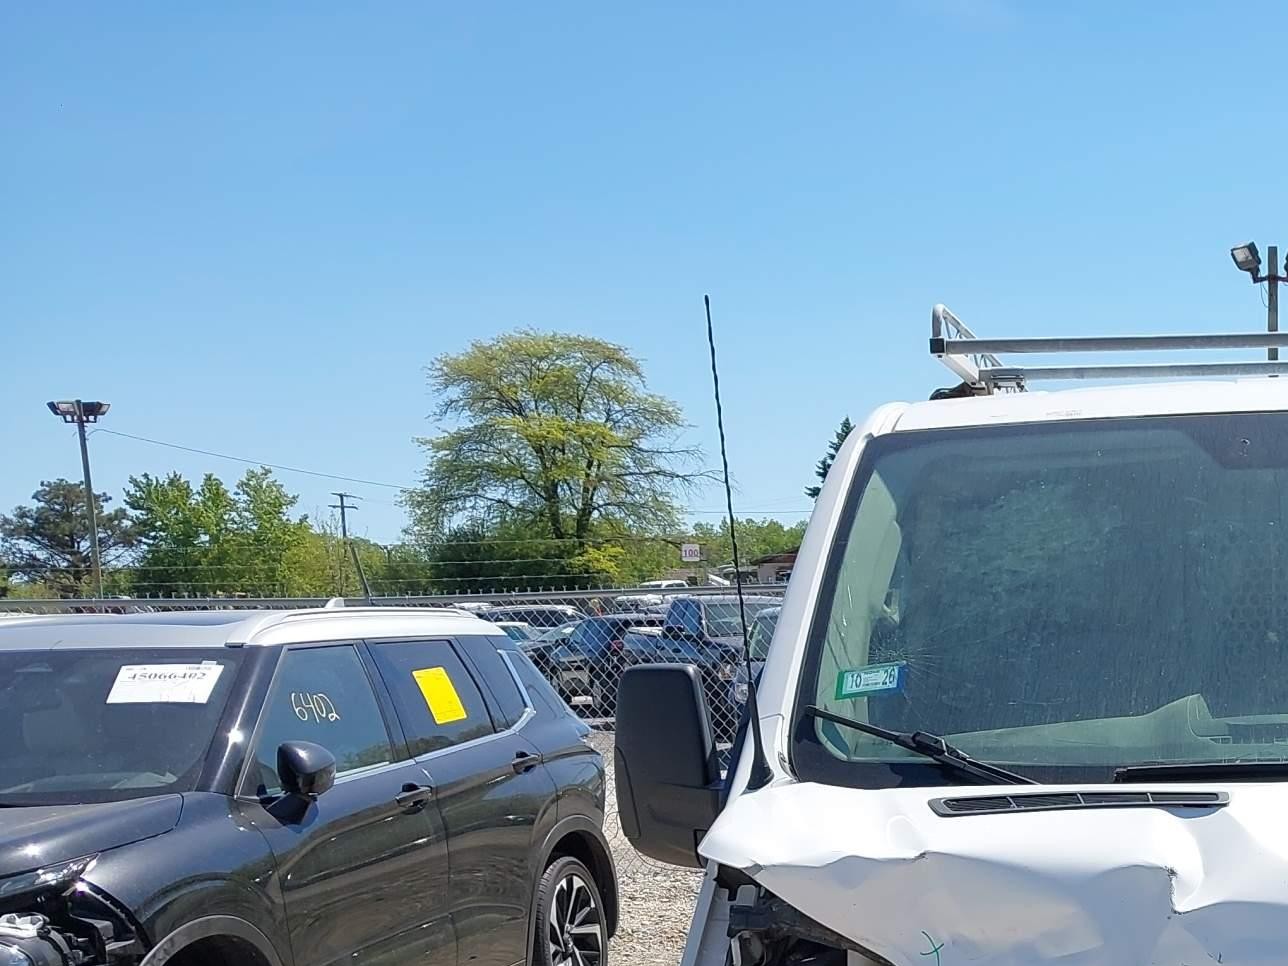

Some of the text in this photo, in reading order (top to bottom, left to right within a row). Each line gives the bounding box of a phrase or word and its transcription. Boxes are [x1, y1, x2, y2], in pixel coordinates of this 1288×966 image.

[684, 549, 699, 557] 100
[128, 672, 207, 680] 45066402
[850, 673, 861, 688] 10
[291, 693, 341, 723] 6402
